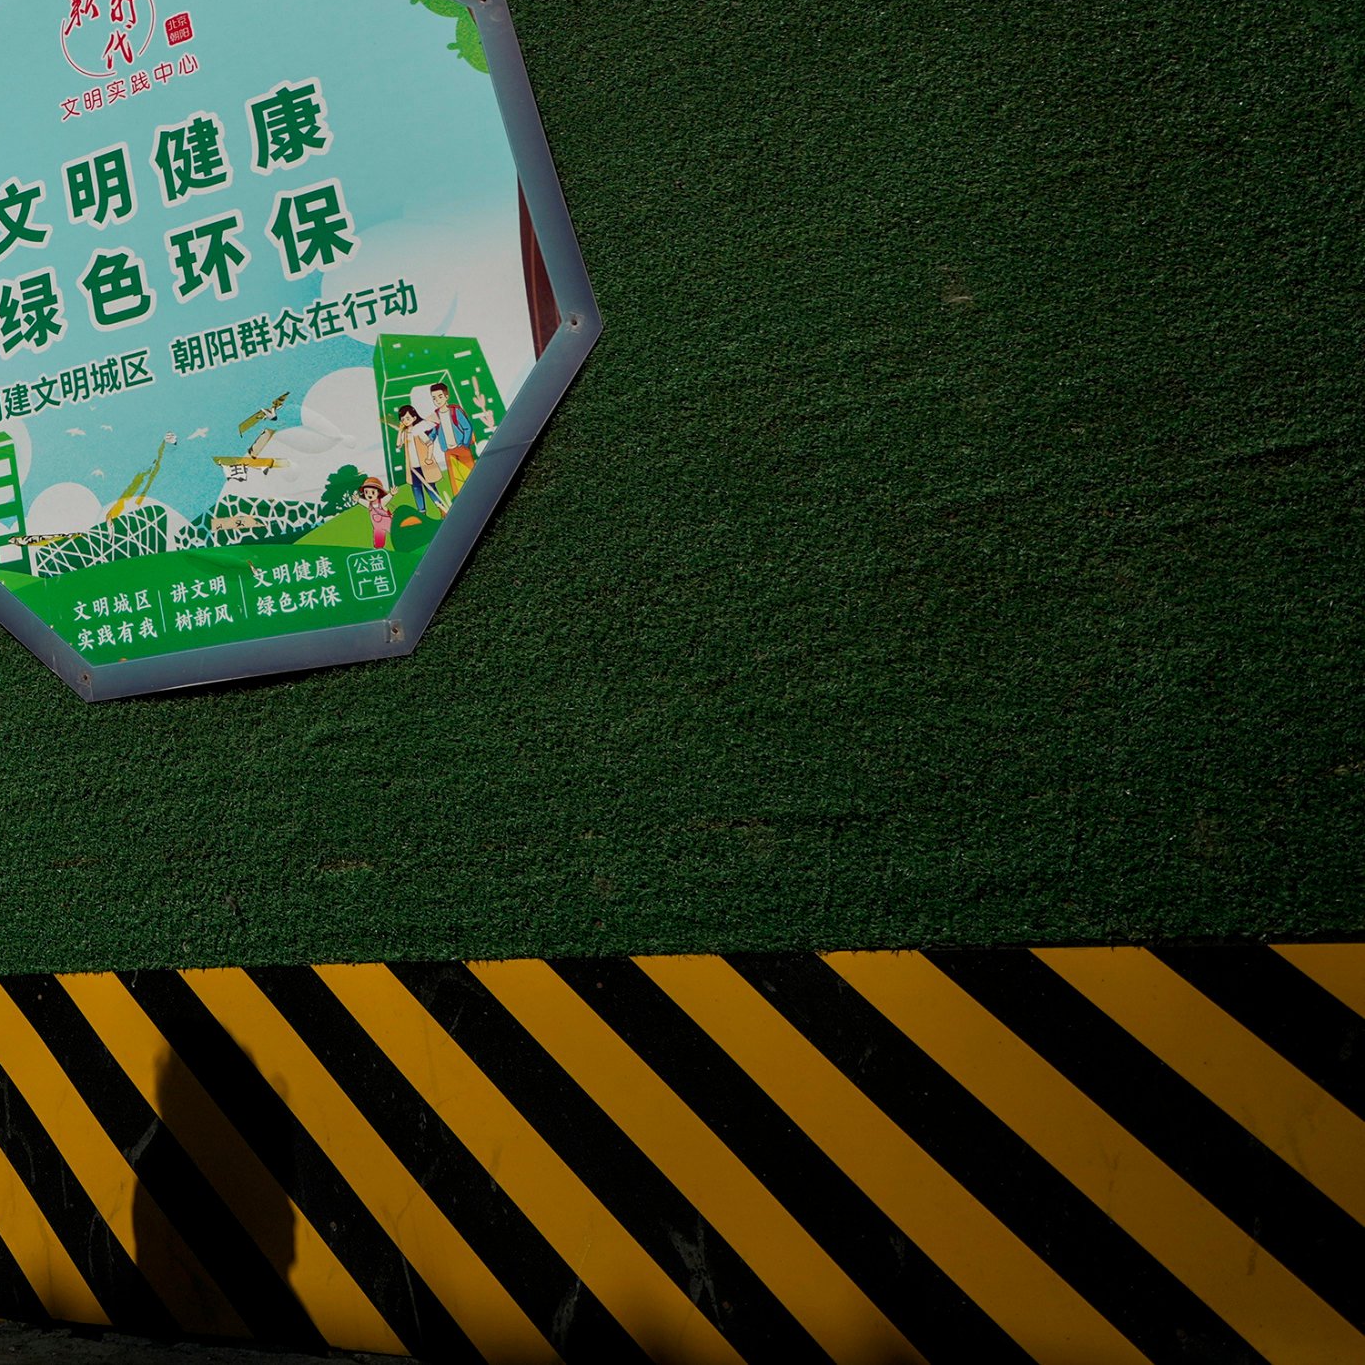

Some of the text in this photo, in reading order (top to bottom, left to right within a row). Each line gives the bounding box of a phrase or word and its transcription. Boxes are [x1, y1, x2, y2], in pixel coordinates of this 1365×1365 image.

[167, 16, 188, 31] 北京
[169, 27, 190, 42] 朝阳
[61, 54, 198, 120] 文明实践中心
[173, 280, 418, 374] 朝阳群众在行动
[253, 557, 336, 588] 文明健康
[353, 555, 386, 573] 公益
[170, 575, 227, 604] 讲文明
[358, 575, 390, 596] 广告
[73, 589, 152, 621] 文明城区
[257, 585, 342, 617] 绿色环保
[175, 604, 233, 631] 树新风
[77, 618, 158, 651] 实践有我
